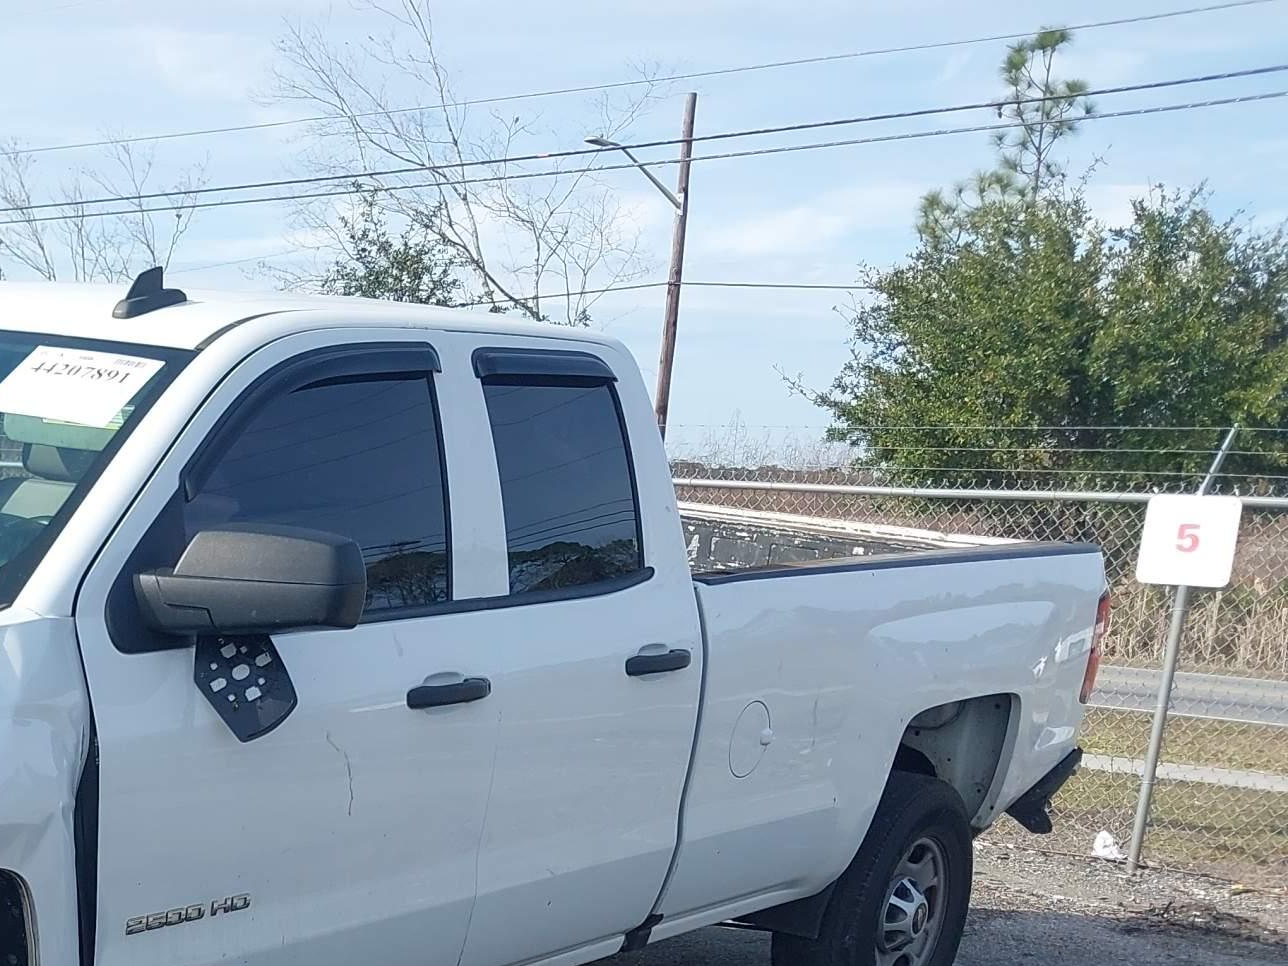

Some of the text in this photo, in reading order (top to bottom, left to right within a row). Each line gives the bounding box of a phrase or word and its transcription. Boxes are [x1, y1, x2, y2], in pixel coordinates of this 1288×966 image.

[30, 361, 131, 384] 44207891
[1176, 524, 1201, 552] 5
[125, 893, 252, 935] 2500 HD
